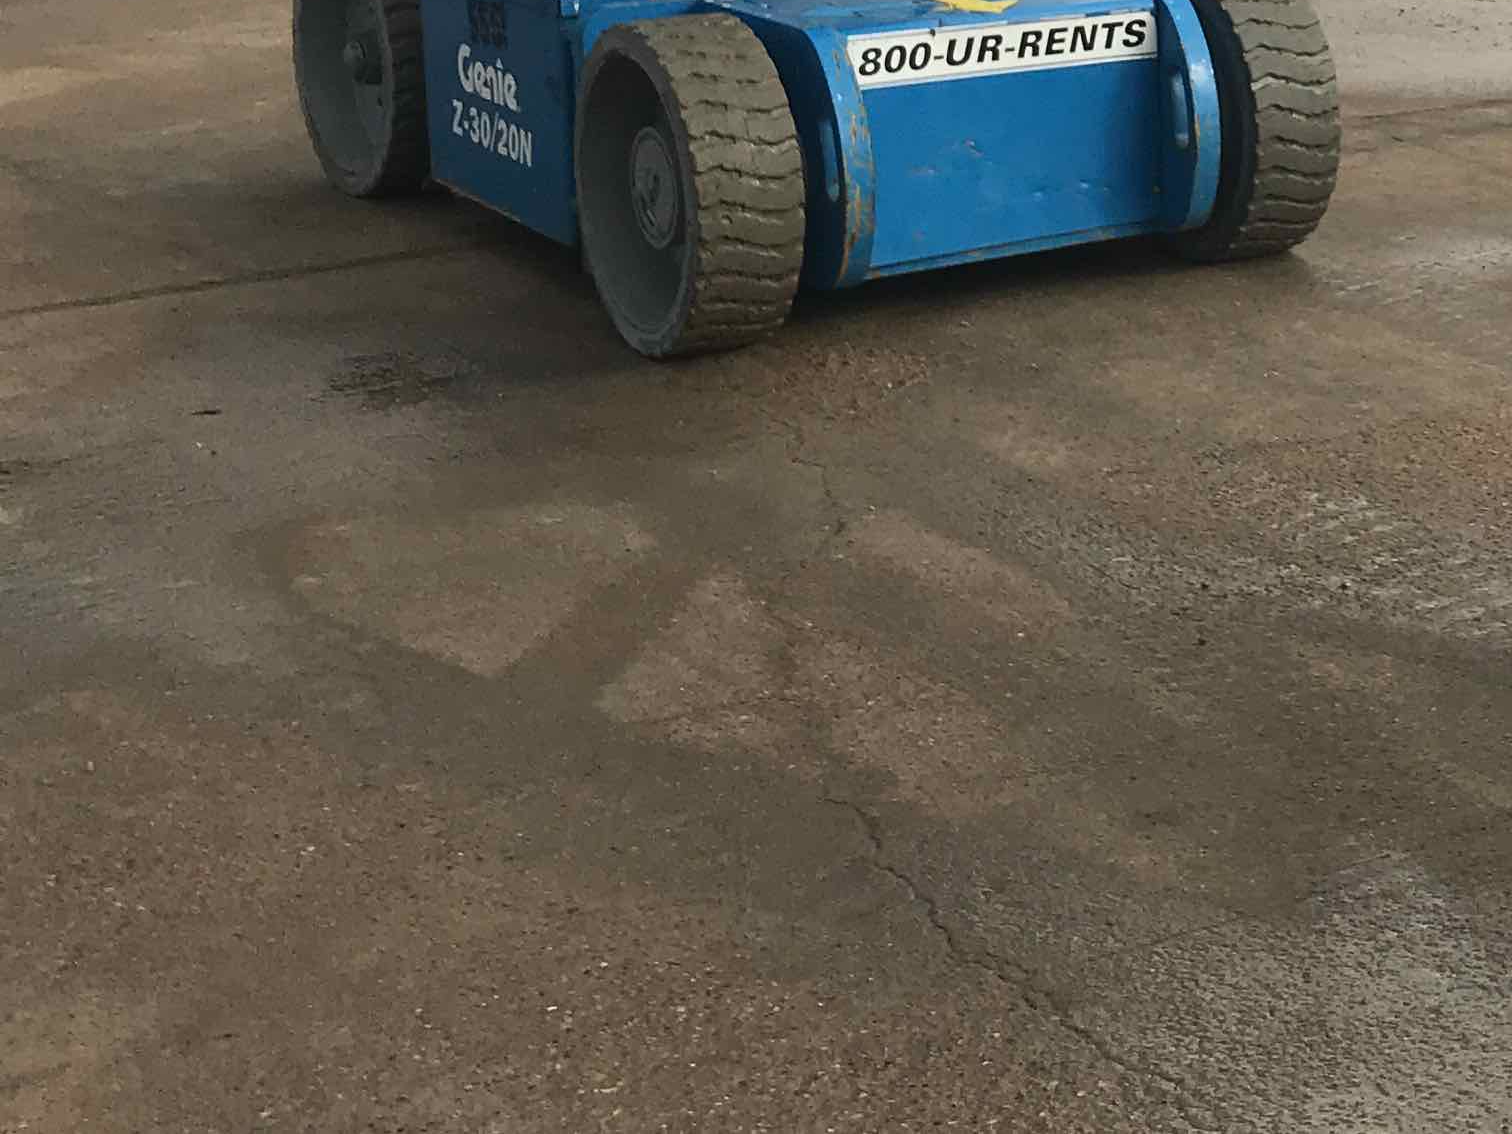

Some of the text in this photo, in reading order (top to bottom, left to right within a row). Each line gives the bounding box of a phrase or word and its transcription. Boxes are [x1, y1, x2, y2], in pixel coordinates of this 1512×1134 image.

[457, 43, 520, 113] Genie
[858, 18, 1148, 76] 800-UR-RENTS
[452, 98, 533, 167] Z-30/20N
